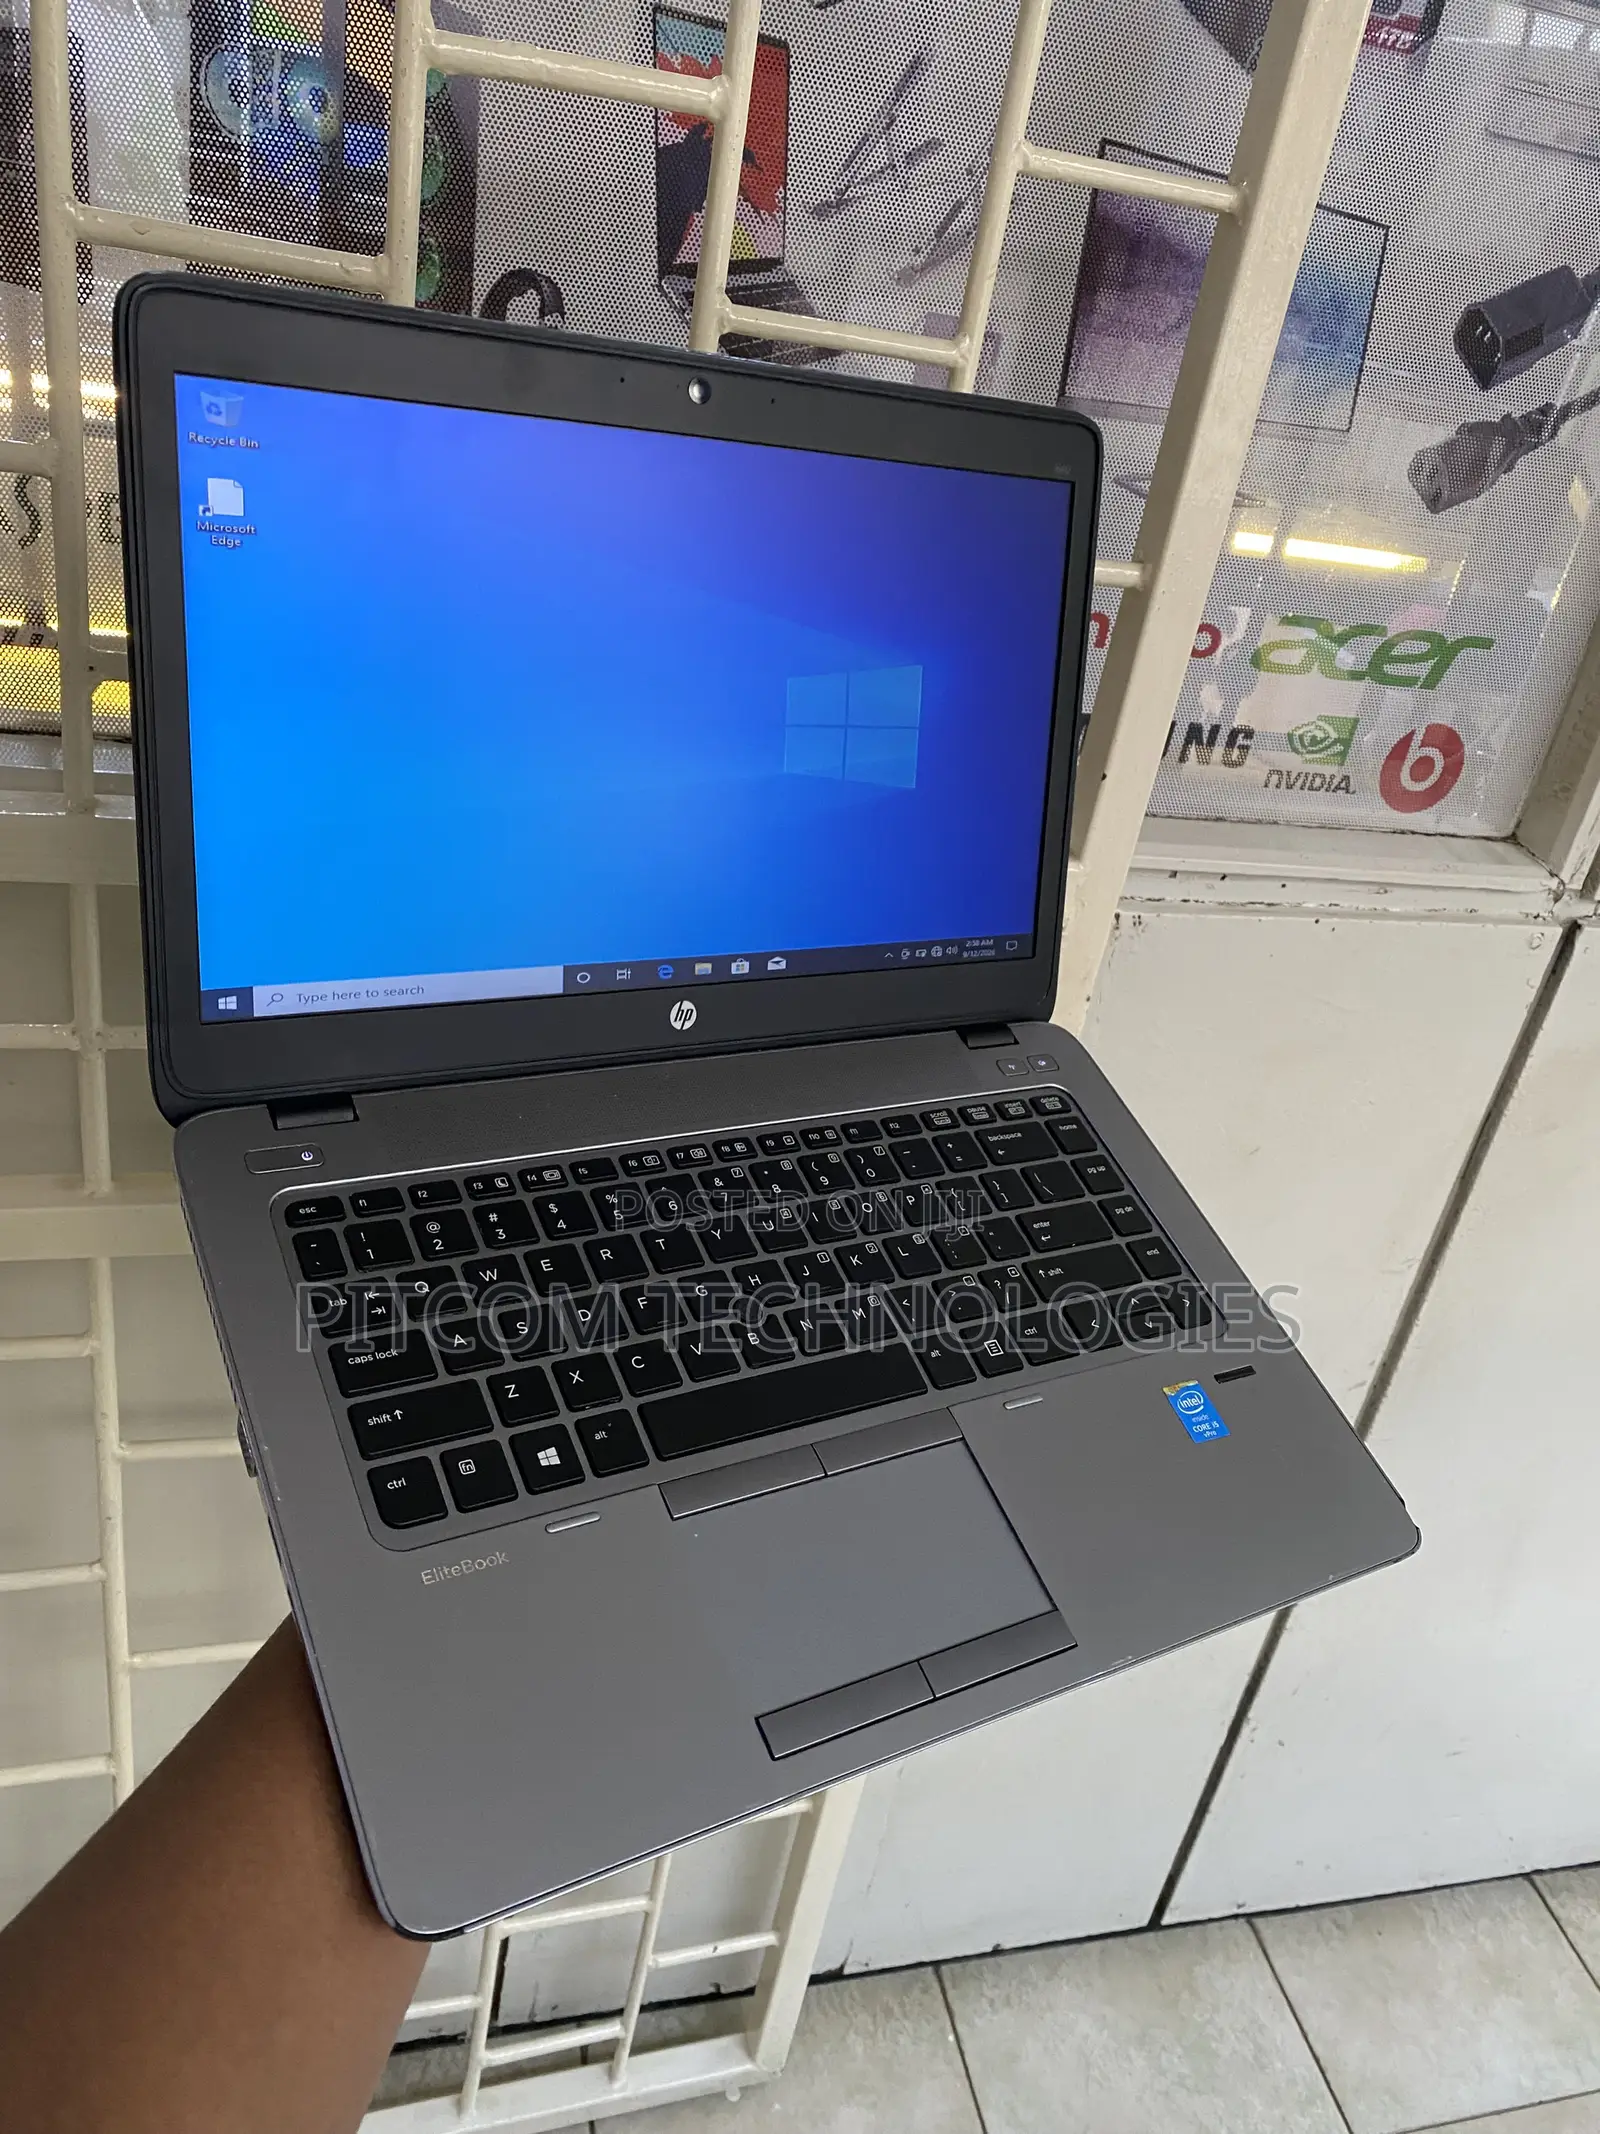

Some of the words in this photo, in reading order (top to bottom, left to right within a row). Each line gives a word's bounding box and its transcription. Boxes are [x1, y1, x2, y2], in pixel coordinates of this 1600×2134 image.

[188, 431, 236, 447] Recycle
[239, 436, 259, 448] Bin
[197, 520, 256, 535] Microsoft
[211, 535, 241, 549] Edge
[1250, 613, 1496, 691] acer
[297, 993, 328, 1005] Type
[332, 990, 361, 1001] here
[365, 989, 379, 998] to
[383, 985, 425, 997] search
[671, 1000, 696, 1030] hp
[930, 1110, 948, 1119] scroll
[988, 1132, 1023, 1142] backspace
[299, 1205, 318, 1215] esc
[426, 1221, 441, 1233] @
[1032, 1221, 1051, 1229] enter
[432, 1239, 444, 1250] 2
[600, 1248, 613, 1261] R
[850, 1254, 863, 1267] K
[540, 1258, 553, 1272] E
[1047, 1267, 1065, 1277] shift
[479, 1268, 498, 1282] W
[748, 1273, 762, 1287] H
[414, 1281, 430, 1294] Q
[695, 1284, 708, 1298] G
[329, 1297, 348, 1307] tab
[577, 1309, 591, 1322] D
[852, 1307, 867, 1321] M
[516, 1321, 530, 1334] S
[800, 1318, 814, 1332] N
[1024, 1326, 1037, 1336] ctrl
[453, 1333, 467, 1348] A
[747, 1332, 760, 1345] B
[347, 1354, 374, 1366] caps
[375, 1348, 399, 1361] lock
[631, 1355, 645, 1369] C
[569, 1369, 584, 1385] X
[504, 1384, 520, 1399] Z
[1179, 1394, 1201, 1409] intel
[367, 1411, 392, 1427] shift
[594, 1428, 608, 1441] alt
[1192, 1422, 1212, 1433] CORE
[1203, 1430, 1218, 1438] vPro
[386, 1477, 407, 1491] ctrl
[421, 1551, 510, 1585] EliteBook
